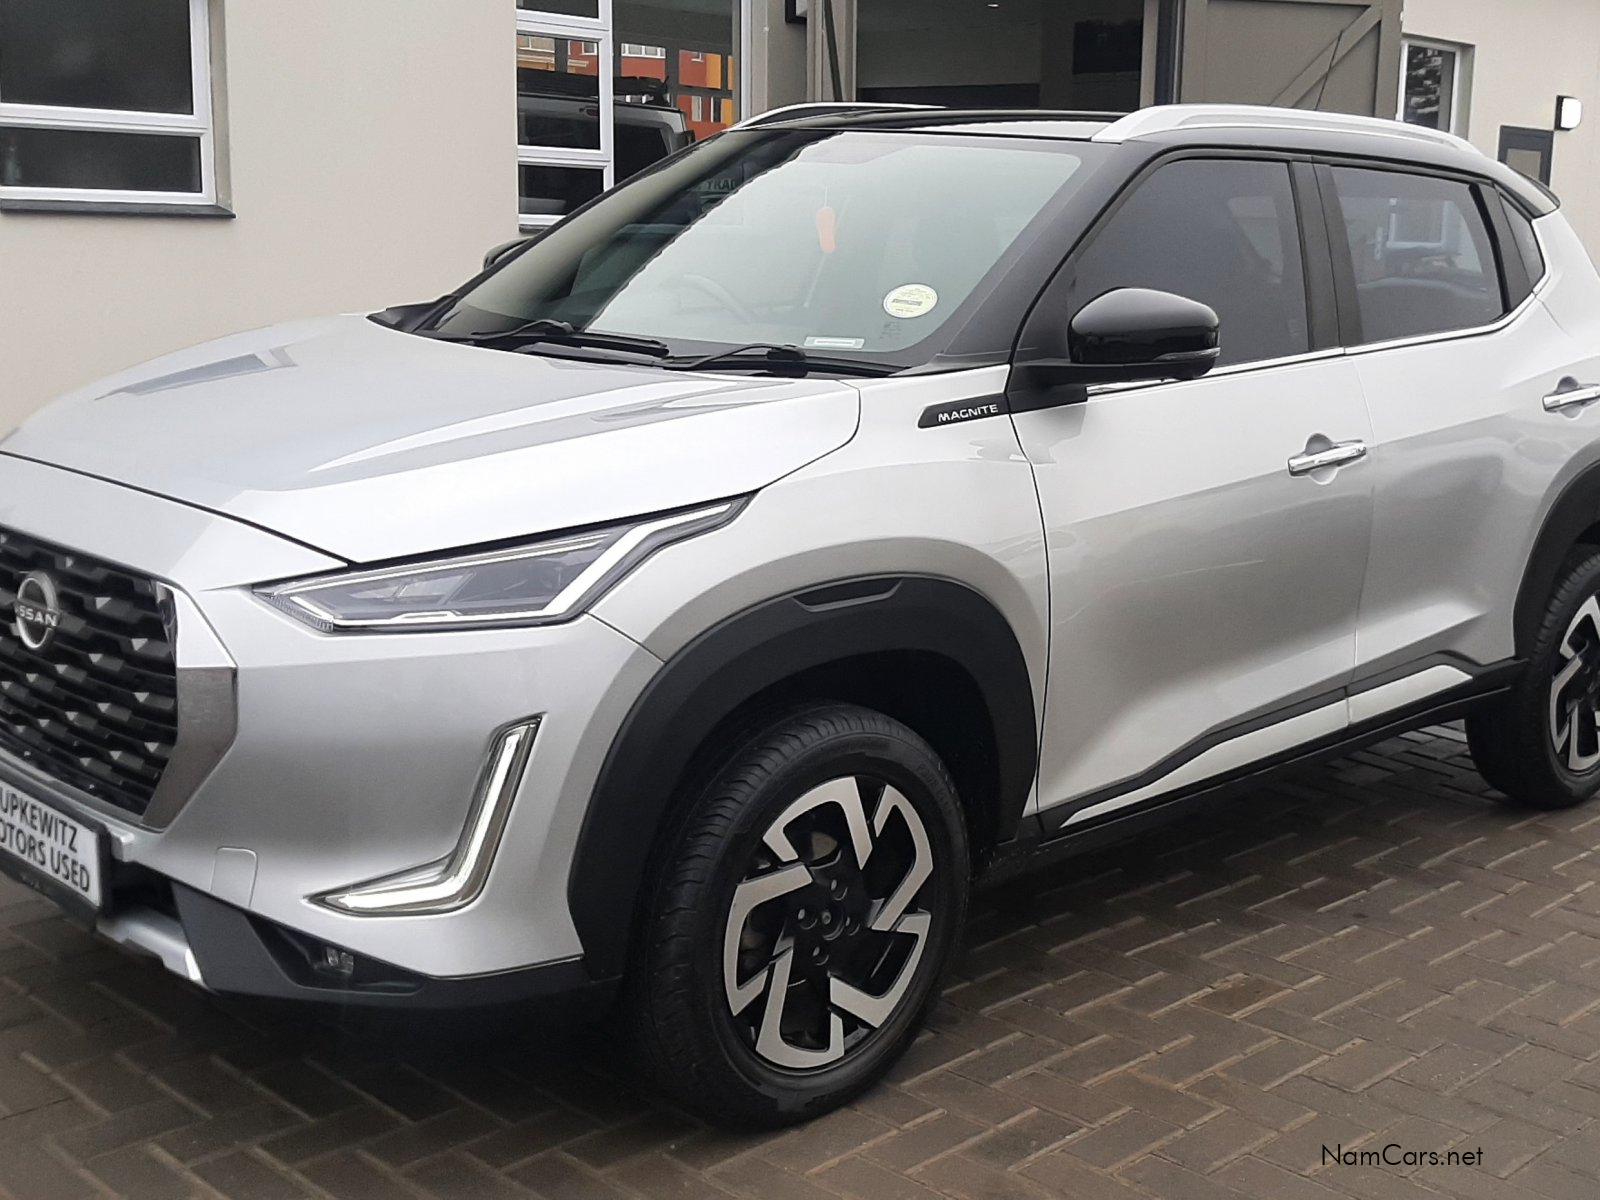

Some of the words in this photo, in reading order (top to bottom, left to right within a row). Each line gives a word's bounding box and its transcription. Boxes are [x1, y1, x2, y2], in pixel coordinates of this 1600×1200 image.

[938, 404, 998, 422] MAGNITE
[14, 603, 57, 627] SSAN
[50, 846, 90, 892] USED
